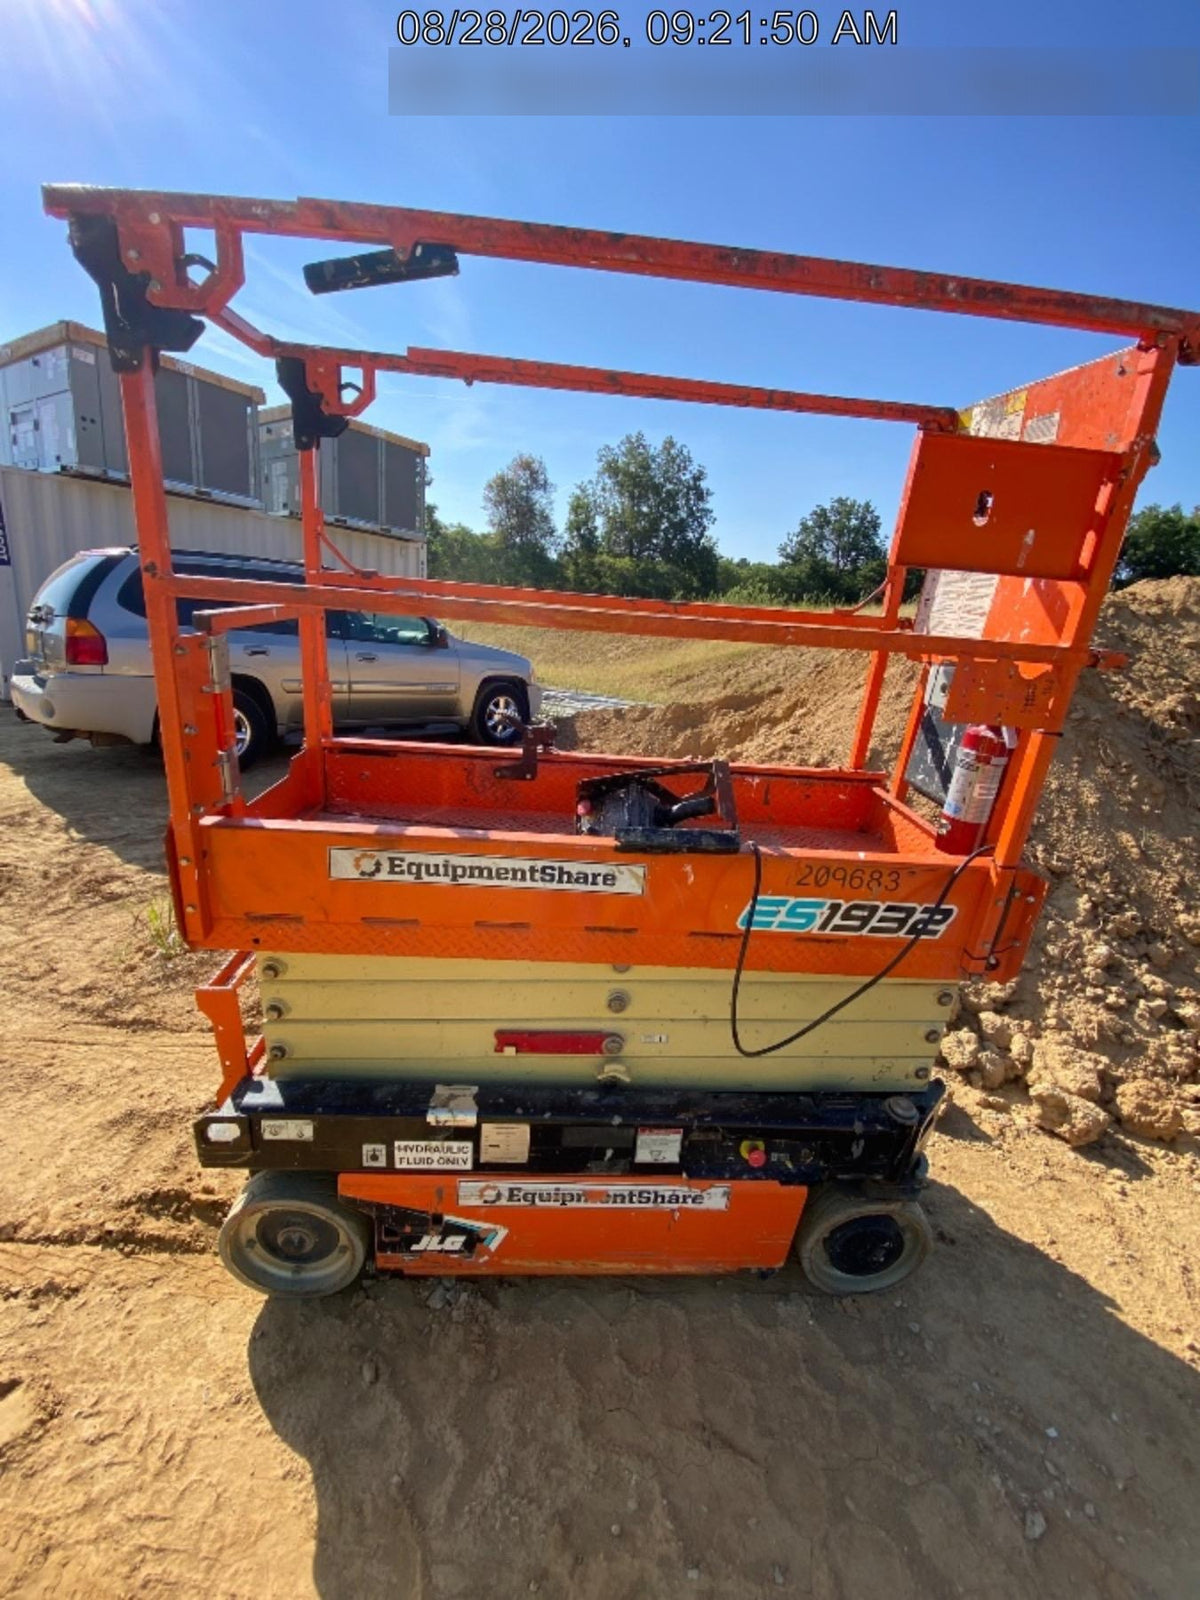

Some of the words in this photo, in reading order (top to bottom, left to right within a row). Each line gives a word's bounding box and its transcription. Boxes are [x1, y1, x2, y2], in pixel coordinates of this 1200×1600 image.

[387, 856, 617, 886] EquipmentShare
[796, 864, 901, 891] 209683
[737, 896, 956, 939] ES1932
[397, 1144, 470, 1154] HYDRAULIC
[398, 1157, 434, 1166] FLUID
[437, 1157, 469, 1166] ONLY
[410, 1235, 467, 1251] JLG
